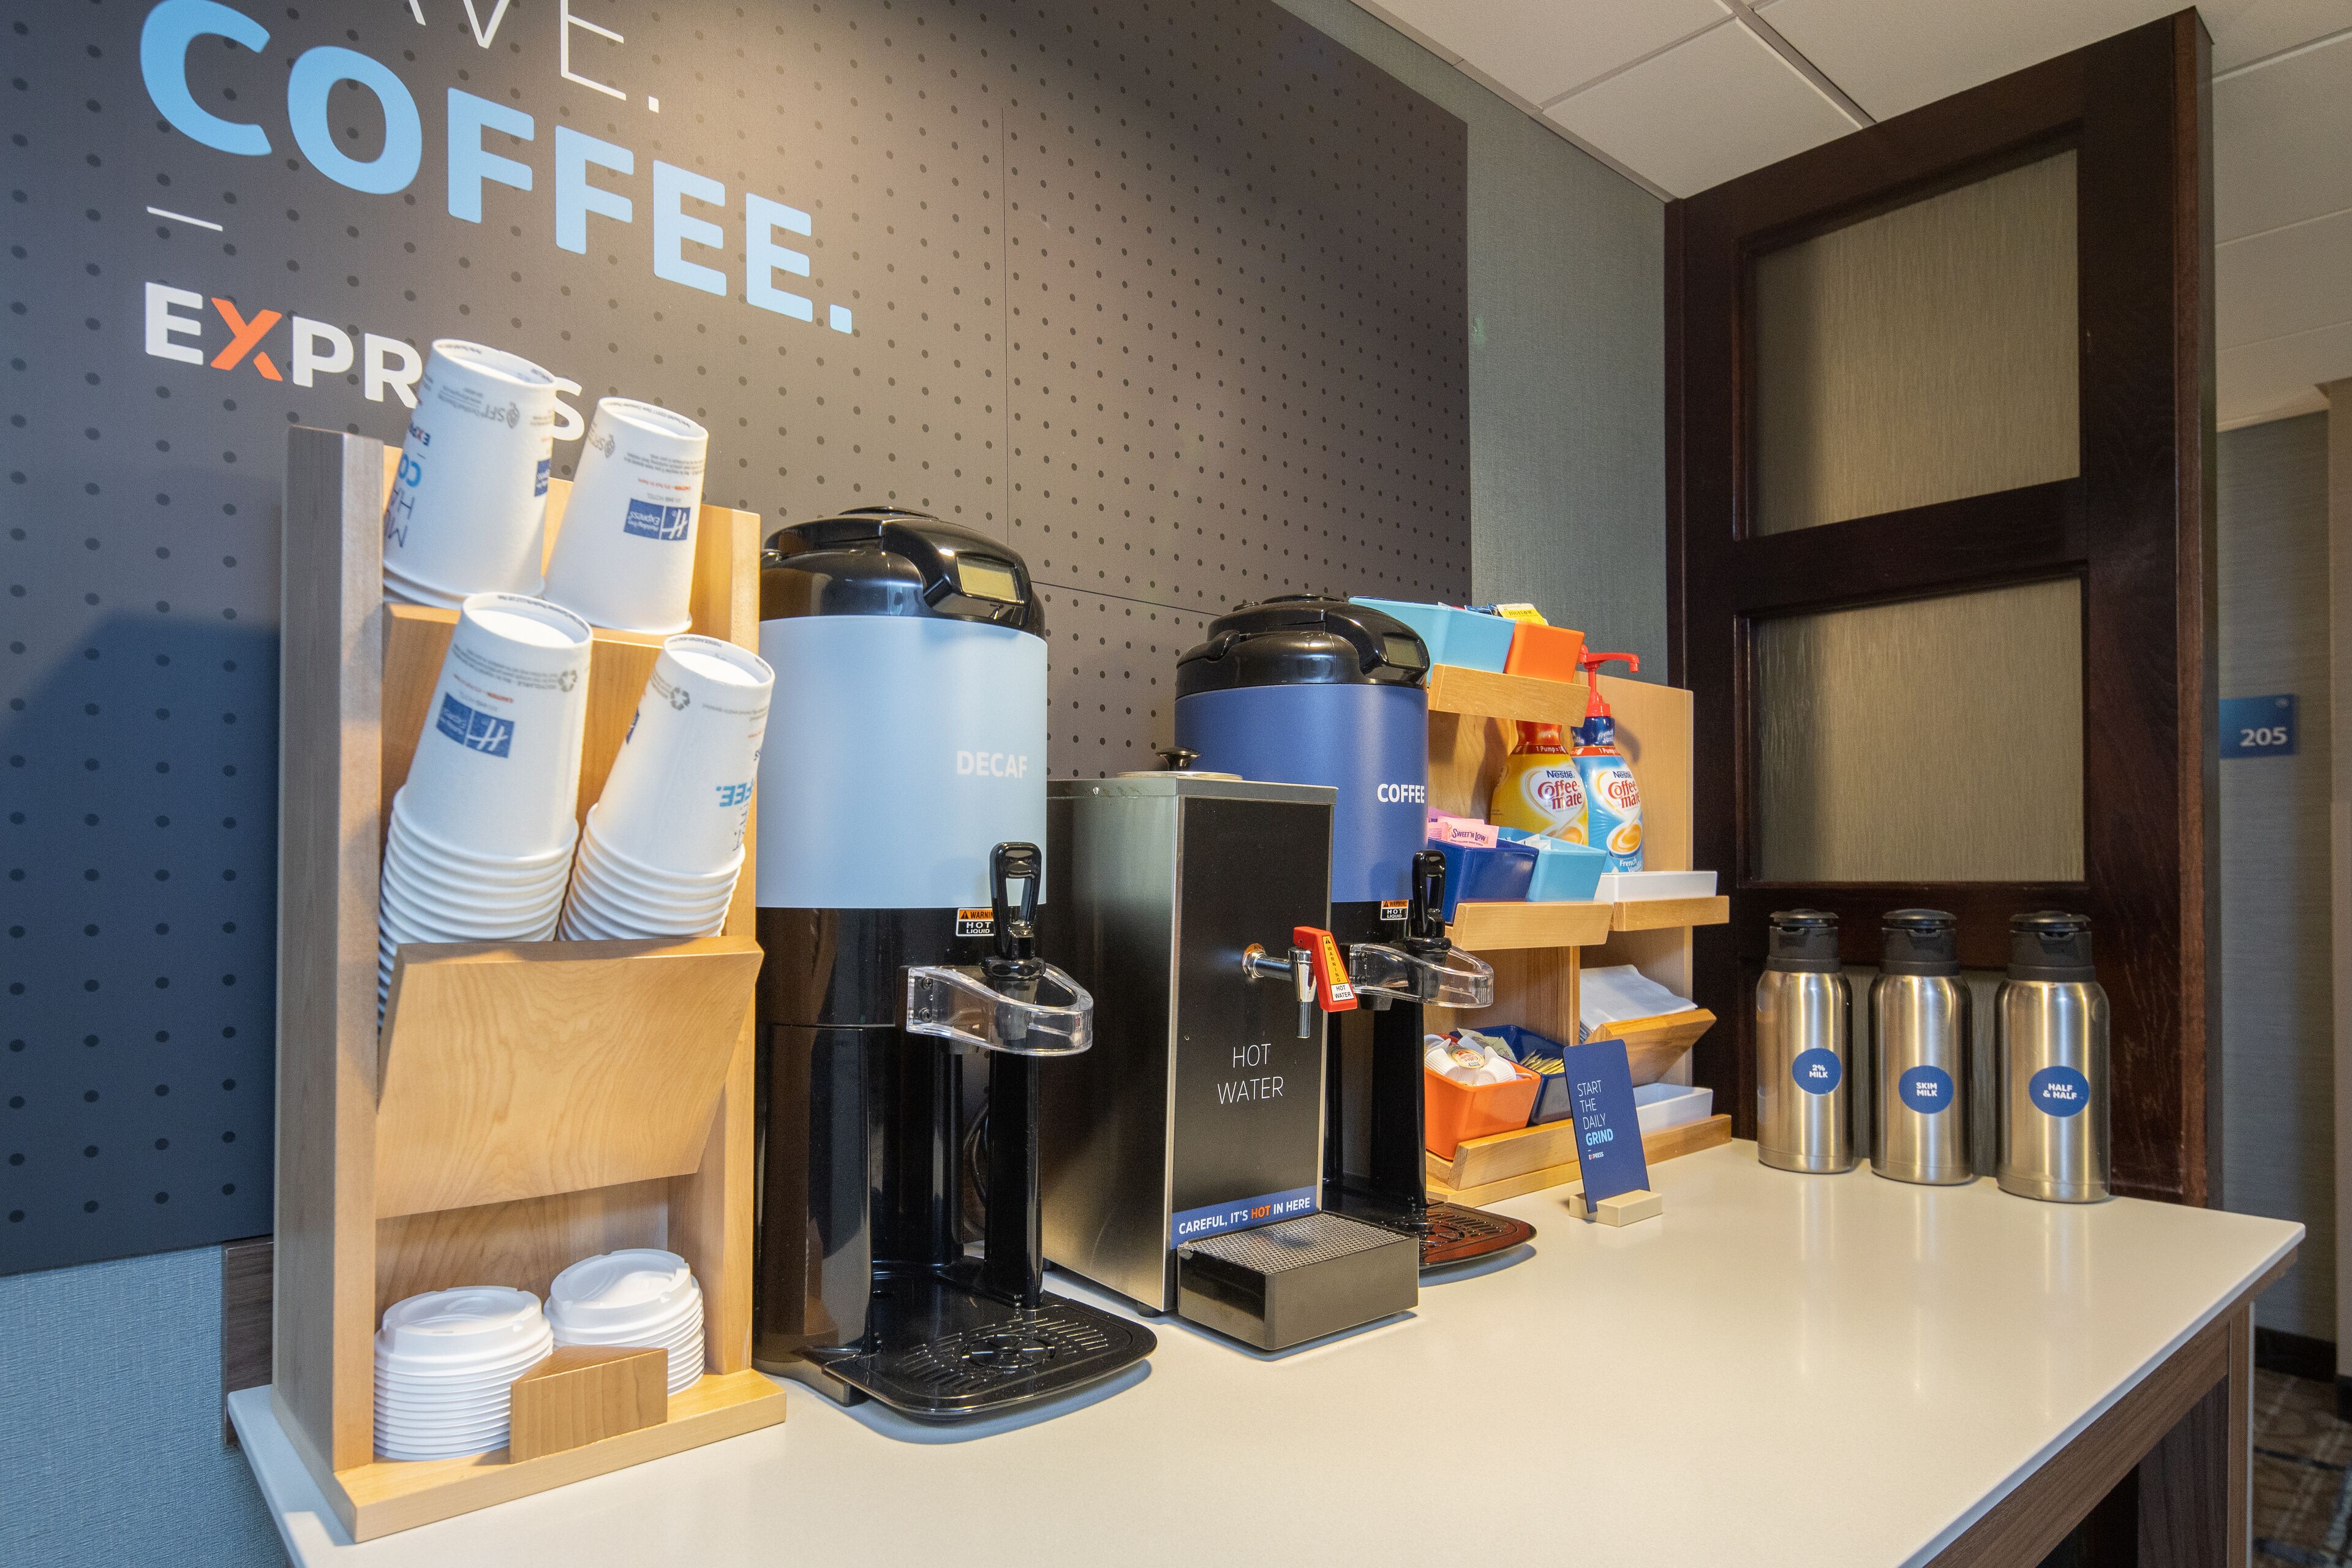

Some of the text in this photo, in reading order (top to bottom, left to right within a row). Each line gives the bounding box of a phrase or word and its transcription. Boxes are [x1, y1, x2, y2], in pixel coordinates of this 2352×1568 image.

[140, 0, 853, 334] COFFEE.
[145, 281, 585, 441] EXPRS
[2240, 726, 2288, 747] 205
[957, 750, 1028, 778] DECAF
[1377, 783, 1425, 804] COFFEE
[1552, 793, 1582, 810] mate
[1327, 946, 1341, 982] WARNING
[1232, 1043, 1272, 1068] HOT
[1217, 1076, 1284, 1104] WATER
[1577, 1080, 1602, 1097] START
[2048, 1083, 2073, 1092] HALF
[2052, 1091, 2077, 1100] HALF
[1579, 1098, 1597, 1113] THE
[1582, 1113, 1605, 1130] DAILY
[1585, 1128, 1613, 1146] GRIND
[1588, 1152, 1604, 1160] EXPRESS
[1178, 1197, 1310, 1235] CAREFUL, IT'S HOT IN HERE
